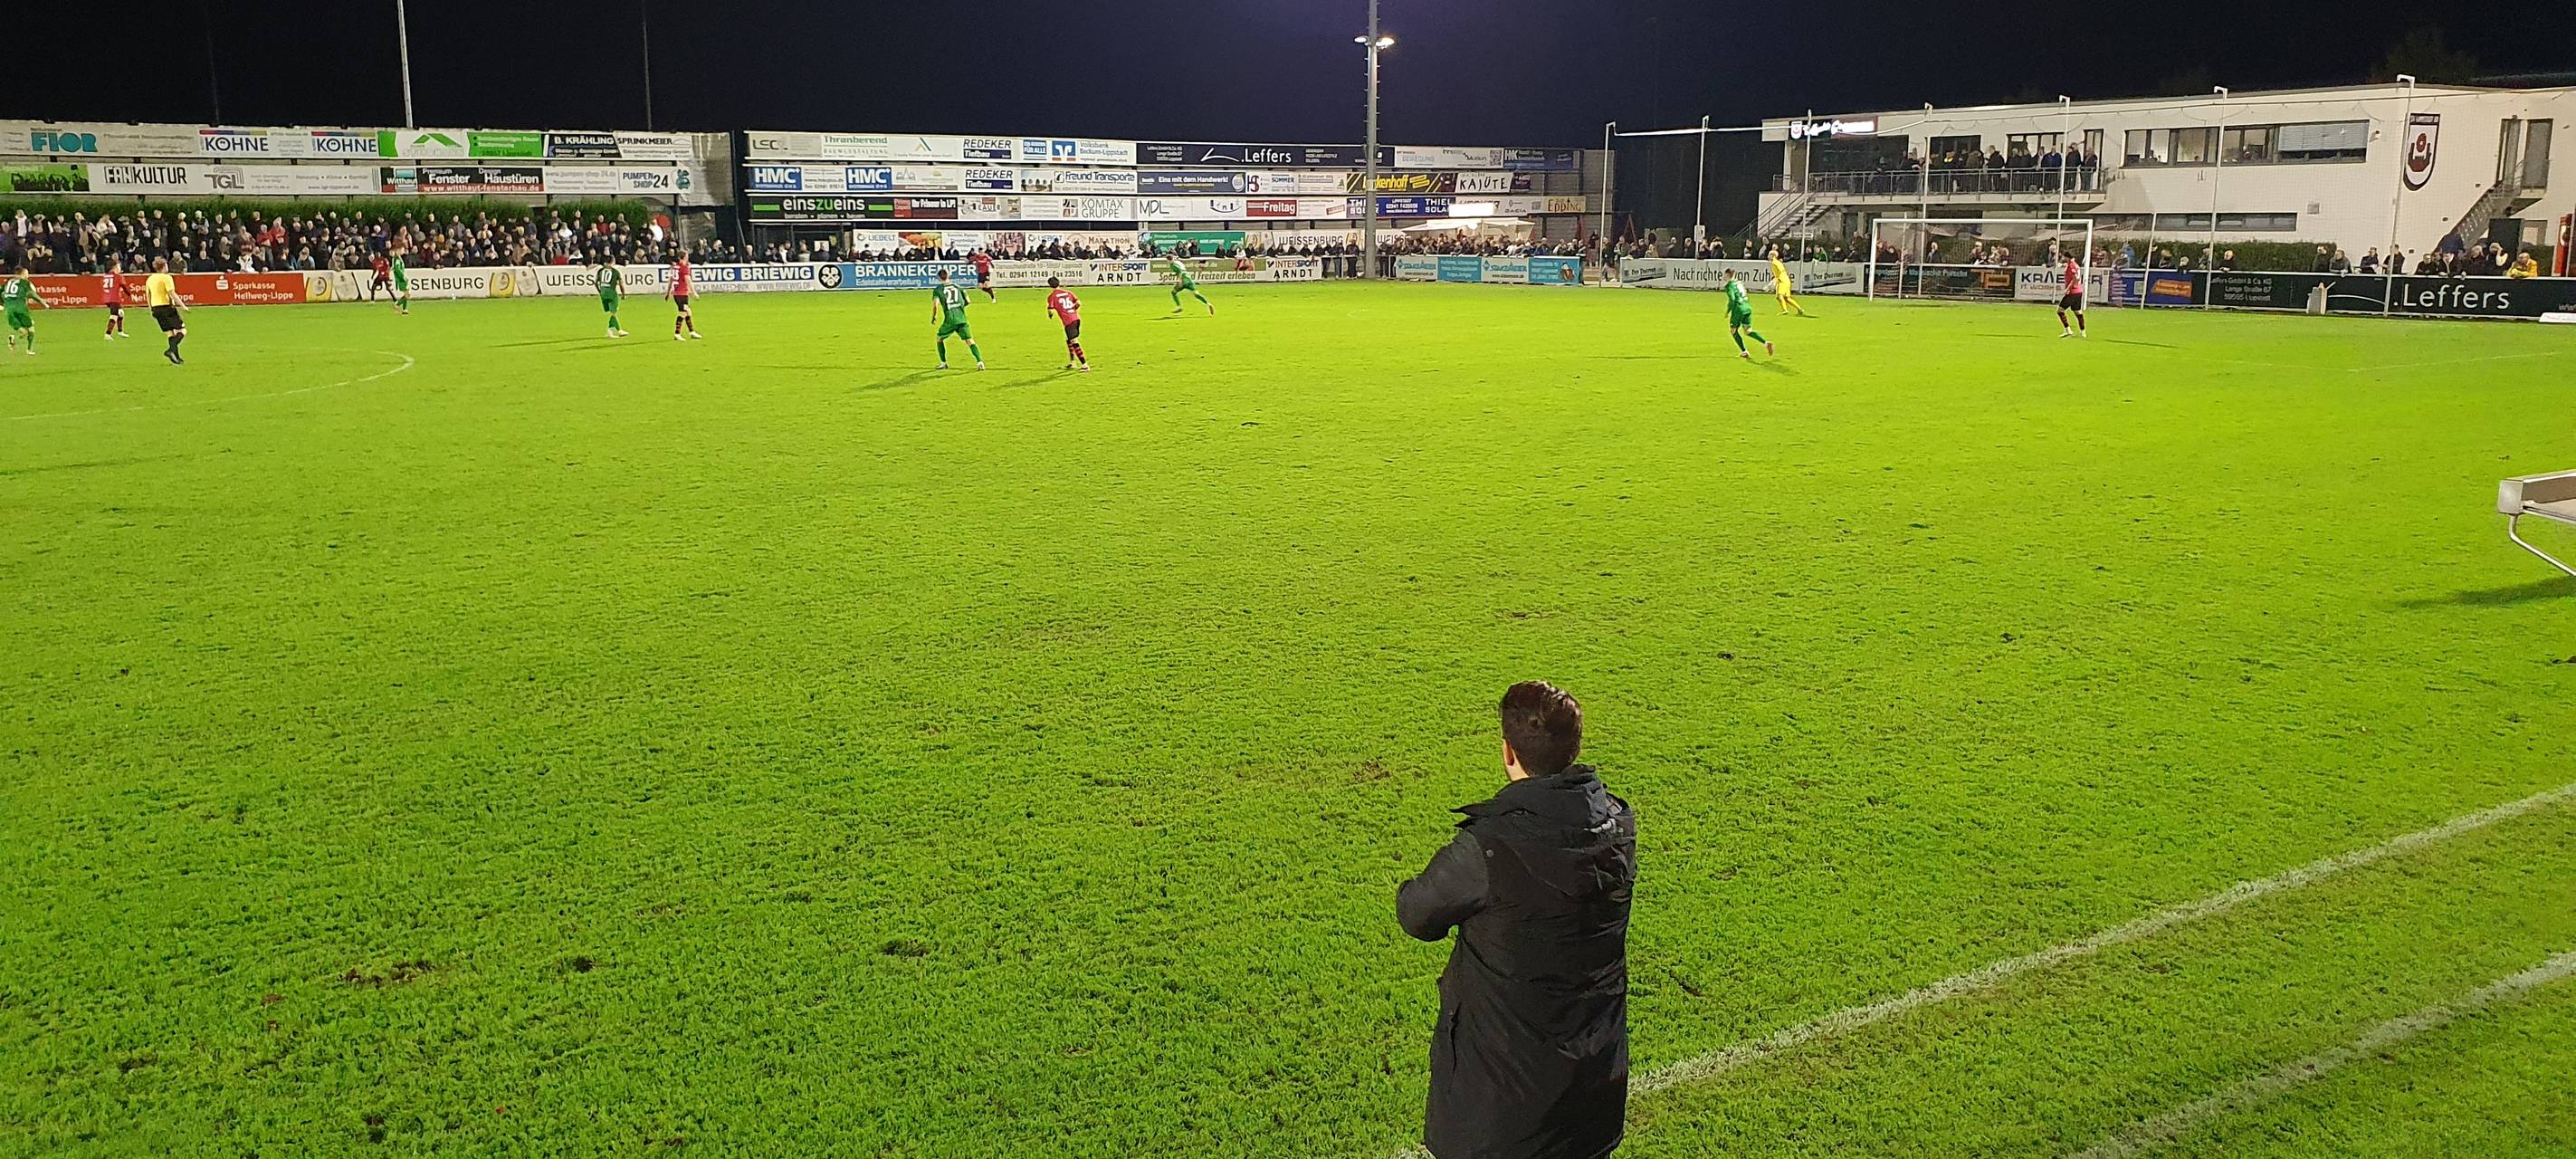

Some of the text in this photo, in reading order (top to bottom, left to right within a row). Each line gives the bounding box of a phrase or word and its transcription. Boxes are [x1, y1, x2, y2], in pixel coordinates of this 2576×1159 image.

[963, 139, 1012, 148] REDEKER
[429, 173, 471, 184] Fenster
[484, 173, 539, 184] Haustüren
[965, 169, 1013, 178] REDEKER
[1065, 171, 1092, 181] Freund
[204, 174, 244, 189] TGL
[623, 172, 669, 188] PUMPEN 24
[633, 180, 654, 188] SHOP
[1459, 177, 1509, 191] KAJÜTE
[783, 197, 865, 211] einszueins
[1081, 199, 1124, 209] KOMTAX
[1263, 202, 1296, 215] Freitag
[1081, 208, 1120, 218] GRUPPE
[1099, 263, 1148, 272] INTERSPORT
[600, 269, 613, 283] 10
[739, 267, 812, 281] BRIEWIG
[1097, 273, 1142, 283] ARNDT
[1274, 269, 1312, 279] ARNDT
[1674, 268, 1725, 281] Nachrichte
[5, 279, 20, 294] 16
[233, 283, 276, 291] Sparkasse
